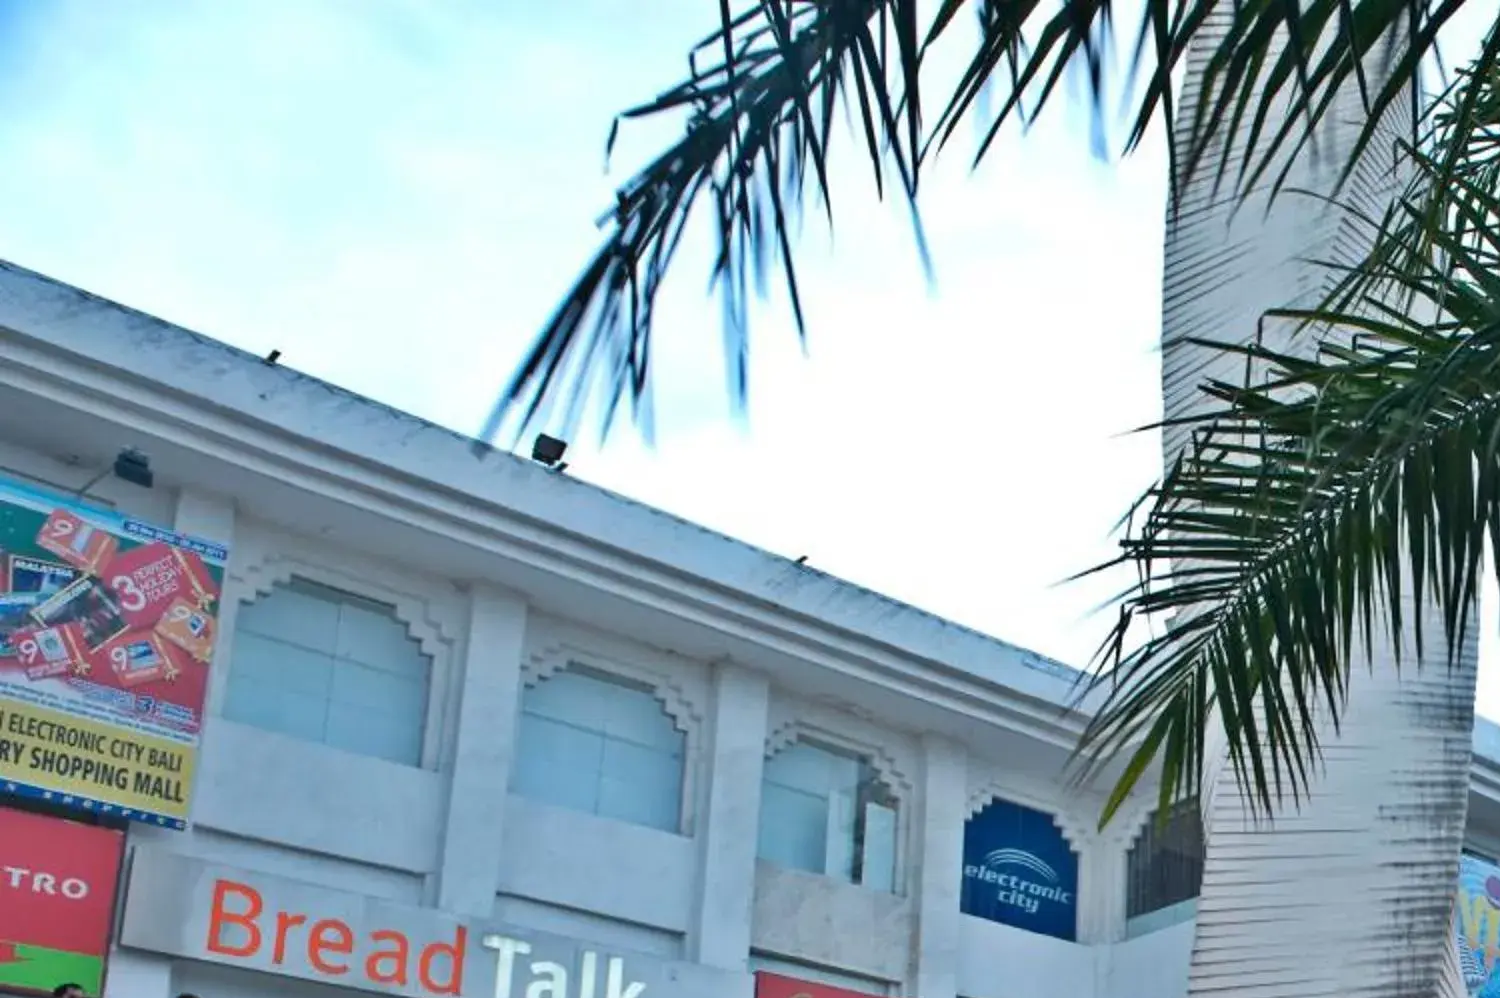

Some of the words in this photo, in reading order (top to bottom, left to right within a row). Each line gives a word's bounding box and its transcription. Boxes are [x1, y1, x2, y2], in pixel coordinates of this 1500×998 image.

[112, 575, 147, 612] 3
[8, 713, 107, 754] ELECTRONIC
[111, 739, 145, 763] CITY
[148, 749, 183, 772] BALI
[29, 746, 130, 790] SHOPPING
[133, 771, 184, 803] MALL
[964, 864, 1072, 904] electronic
[997, 889, 1039, 914] city
[206, 879, 468, 997] Bread
